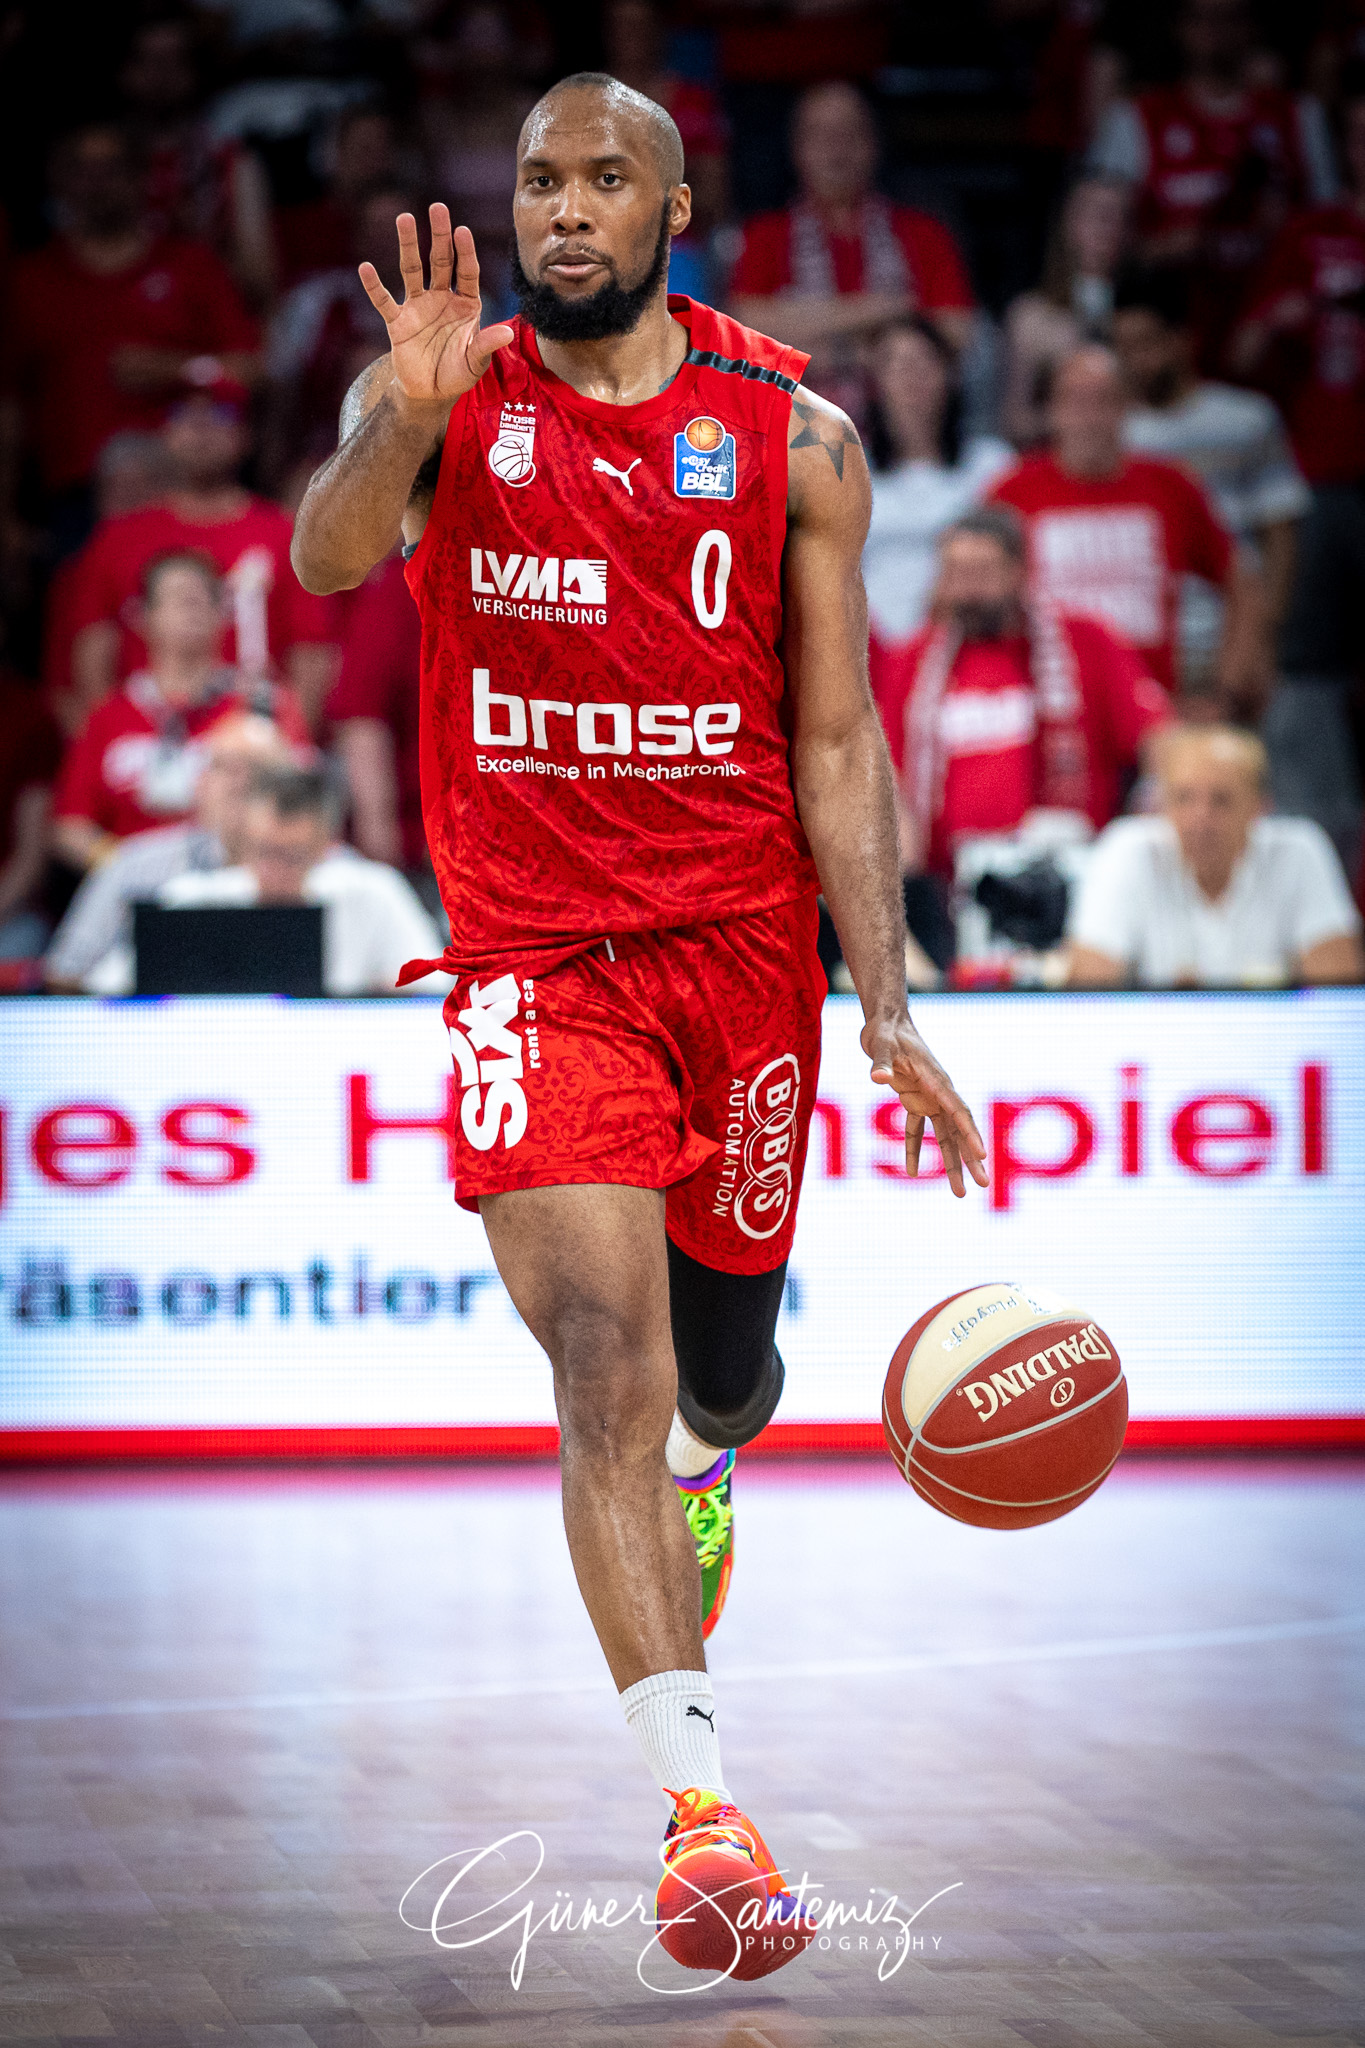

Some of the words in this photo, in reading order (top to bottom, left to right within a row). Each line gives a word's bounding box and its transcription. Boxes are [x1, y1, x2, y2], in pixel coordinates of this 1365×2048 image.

[499, 421, 536, 434] bamberg
[501, 410, 536, 425] brose
[681, 472, 727, 492] BBL
[471, 547, 559, 602] LVM
[691, 529, 732, 629] 0
[472, 597, 607, 625] VERSICHERUNG
[473, 668, 741, 756] brose
[476, 755, 581, 780] Excellence
[587, 763, 606, 779] in
[523, 979, 535, 1003] ca
[525, 1010, 537, 1021] a
[525, 1027, 541, 1069] rent
[0, 1098, 256, 1212] es
[712, 1078, 746, 1217] AUTOMATION
[963, 1323, 1112, 1423] SPALDING
